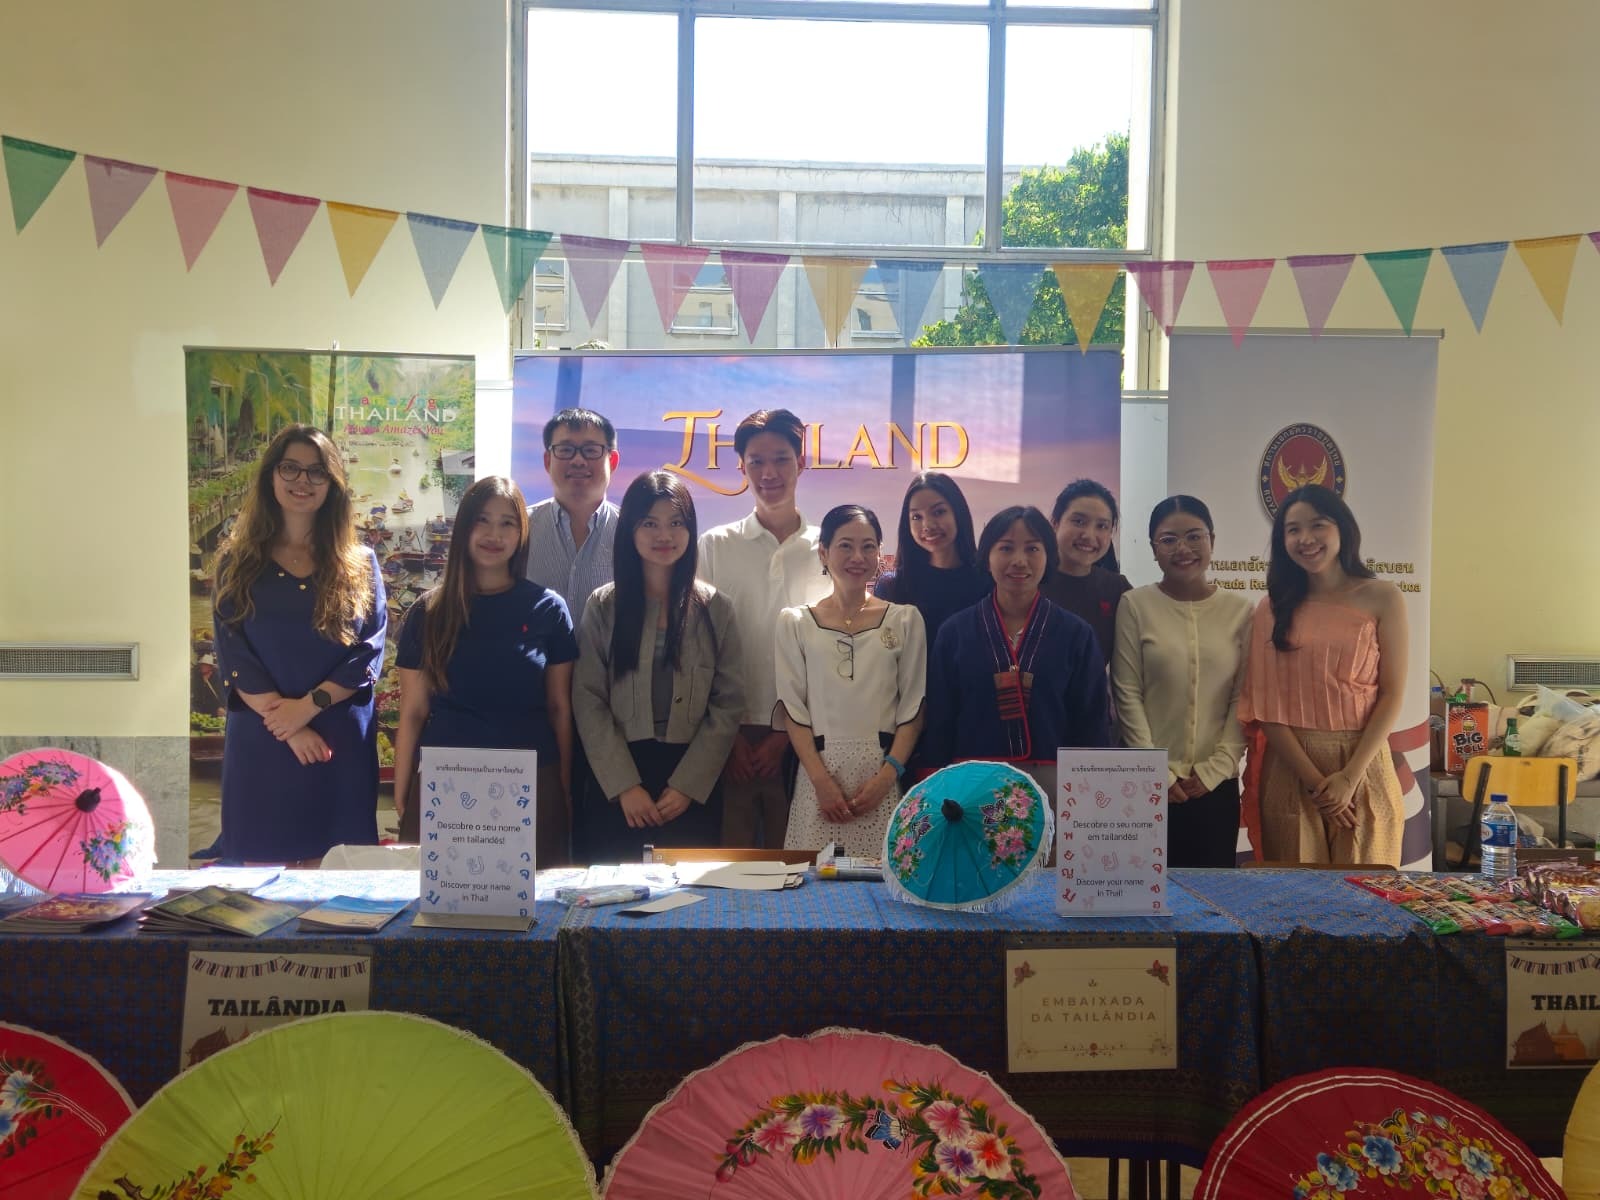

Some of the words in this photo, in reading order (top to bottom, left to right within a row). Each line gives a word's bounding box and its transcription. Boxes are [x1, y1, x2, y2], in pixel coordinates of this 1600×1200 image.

[335, 406, 457, 422] THAILAND
[662, 408, 969, 496] THLAND
[437, 821, 473, 831] Descobre
[1073, 820, 1108, 829] Descobre
[440, 881, 470, 889] Discover
[472, 883, 488, 891] your
[1076, 878, 1105, 886] Discover
[1107, 879, 1122, 887] your
[207, 996, 346, 1016] TAILÂNDIA
[1041, 996, 1145, 1007] EMBAIXADA
[1531, 994, 1600, 1011] THAIL
[1031, 1012, 1053, 1023] DA
[1062, 1010, 1156, 1023] TAILÂNDIA
